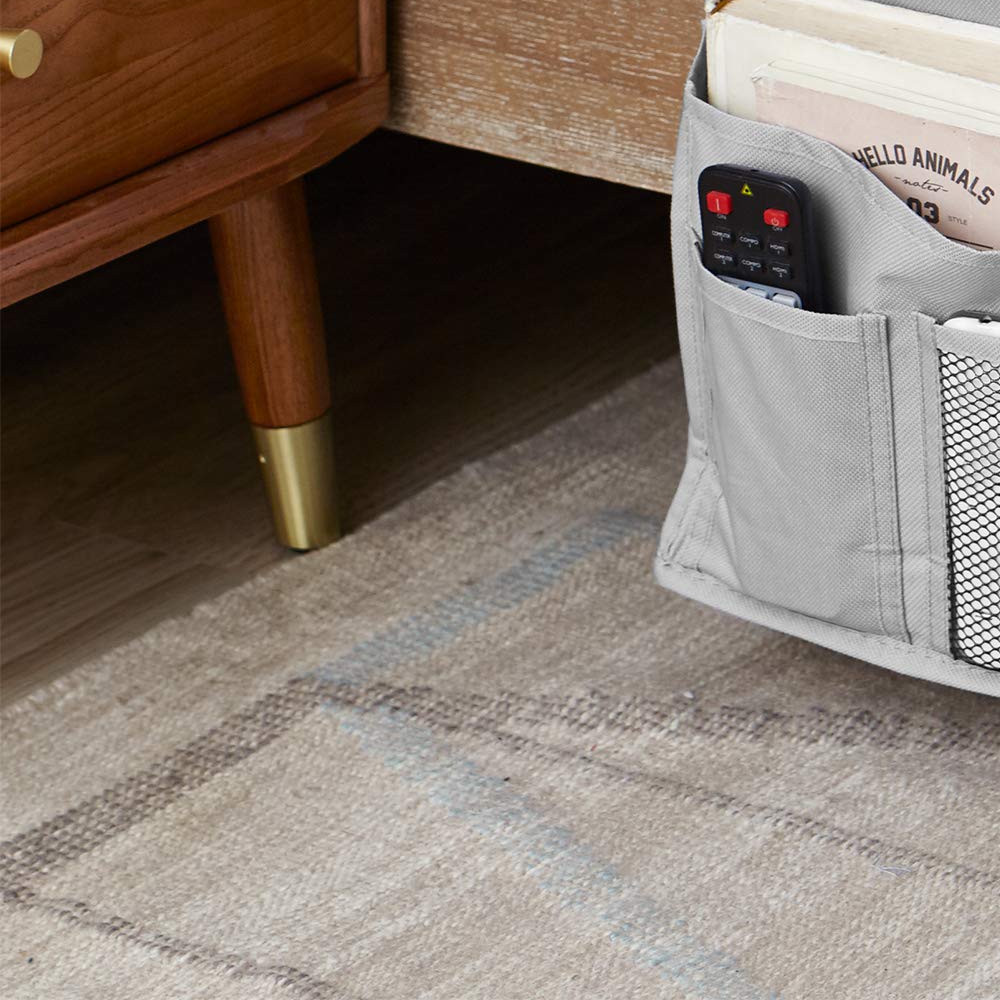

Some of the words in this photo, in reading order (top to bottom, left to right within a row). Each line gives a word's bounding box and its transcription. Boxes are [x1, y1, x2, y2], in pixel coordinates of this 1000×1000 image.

[851, 143, 907, 170] HELLO
[912, 146, 995, 206] ANIMALS
[947, 215, 968, 226] STYLE
